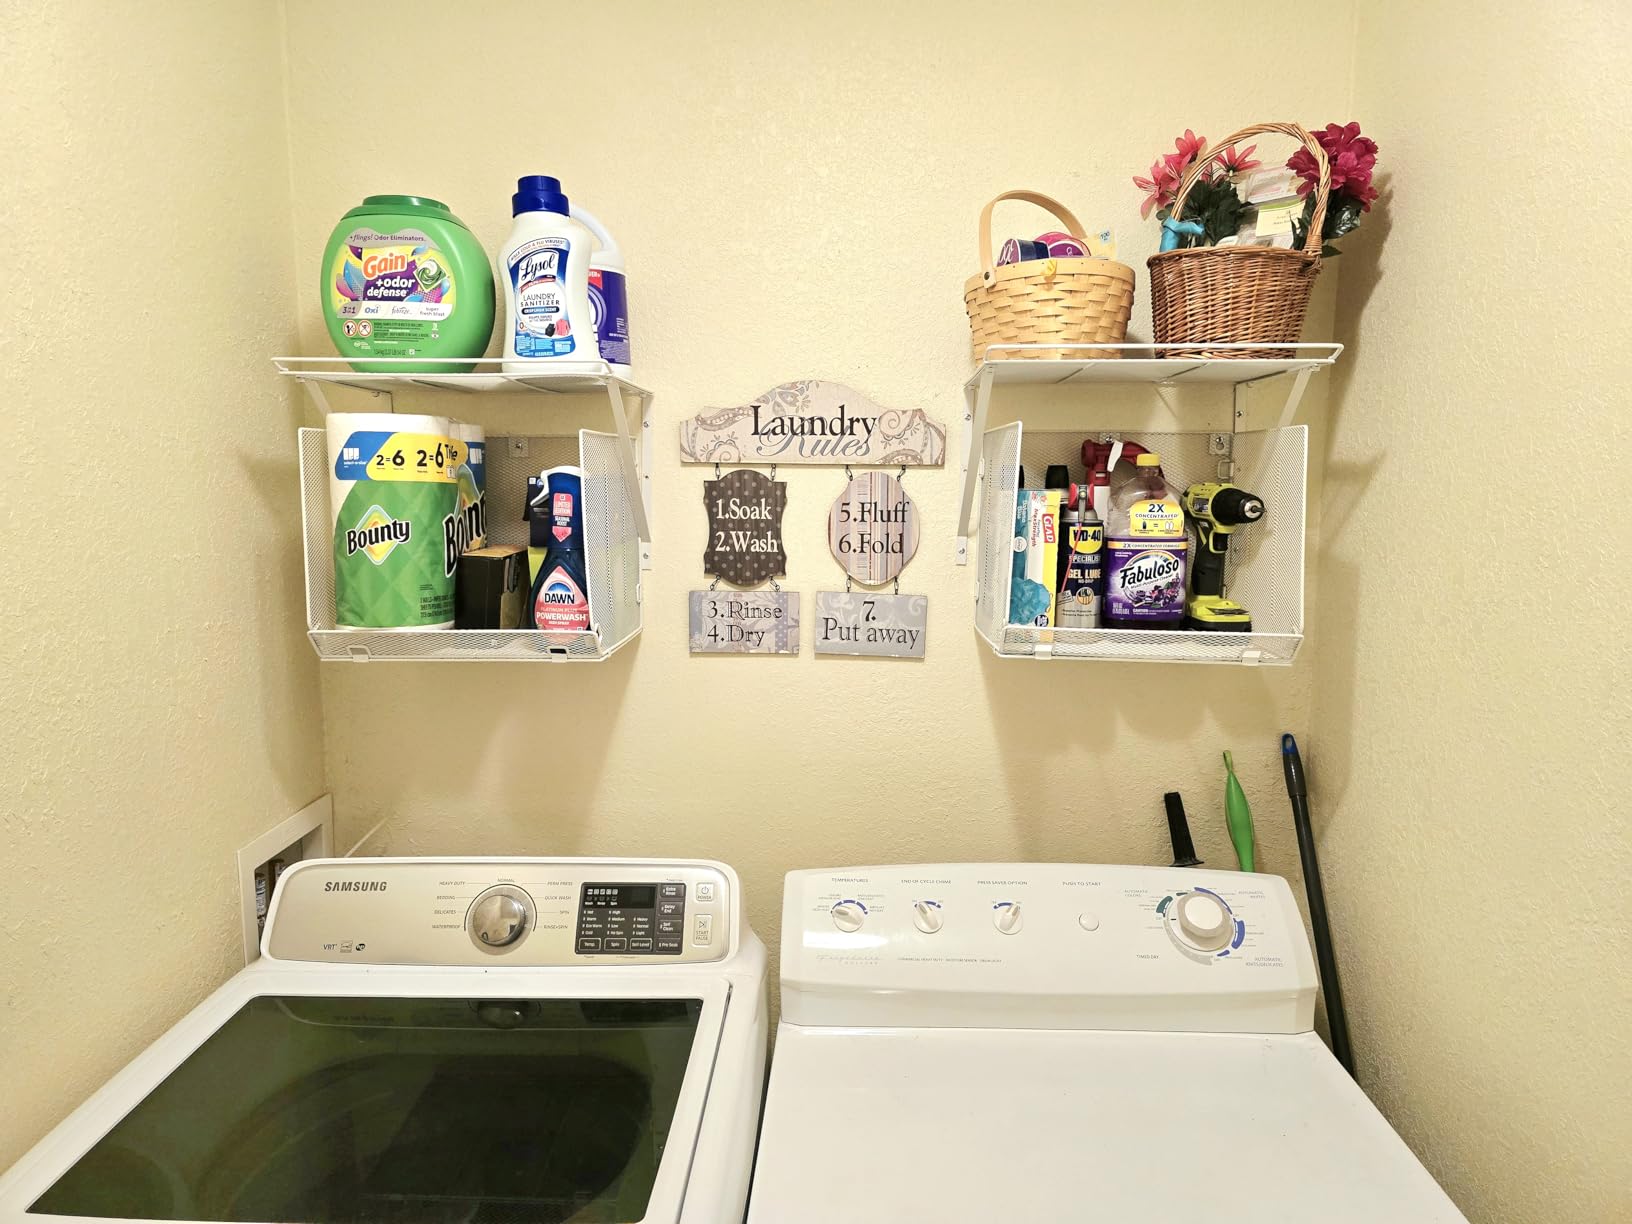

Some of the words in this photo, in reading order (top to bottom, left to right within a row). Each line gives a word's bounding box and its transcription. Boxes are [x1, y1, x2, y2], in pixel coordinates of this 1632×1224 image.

[363, 252, 406, 279] Gain
[520, 253, 556, 281] Lysol
[366, 288, 408, 298] defense
[520, 300, 560, 308] SANITIZER
[523, 293, 556, 301] LAUNDRY
[750, 405, 877, 444] Laundry
[756, 416, 873, 458] Rules
[716, 498, 773, 520] 1.Soak
[838, 501, 909, 524] 5.Fluff
[1148, 503, 1165, 513] 2X
[347, 519, 411, 556] Bounty
[1043, 515, 1055, 543] GLAD
[716, 530, 779, 553] 2.Wash
[838, 532, 904, 555] 6.Fold
[1120, 558, 1179, 589] Fabuloso
[544, 593, 575, 605] DAWN
[707, 600, 783, 619] 3.Rinse
[536, 611, 586, 621] POWERWASH
[863, 600, 877, 622] 7.
[707, 624, 766, 647] 4.Dry
[822, 617, 861, 641] Put
[866, 628, 920, 649] away
[324, 881, 388, 892] SAMSUNG
